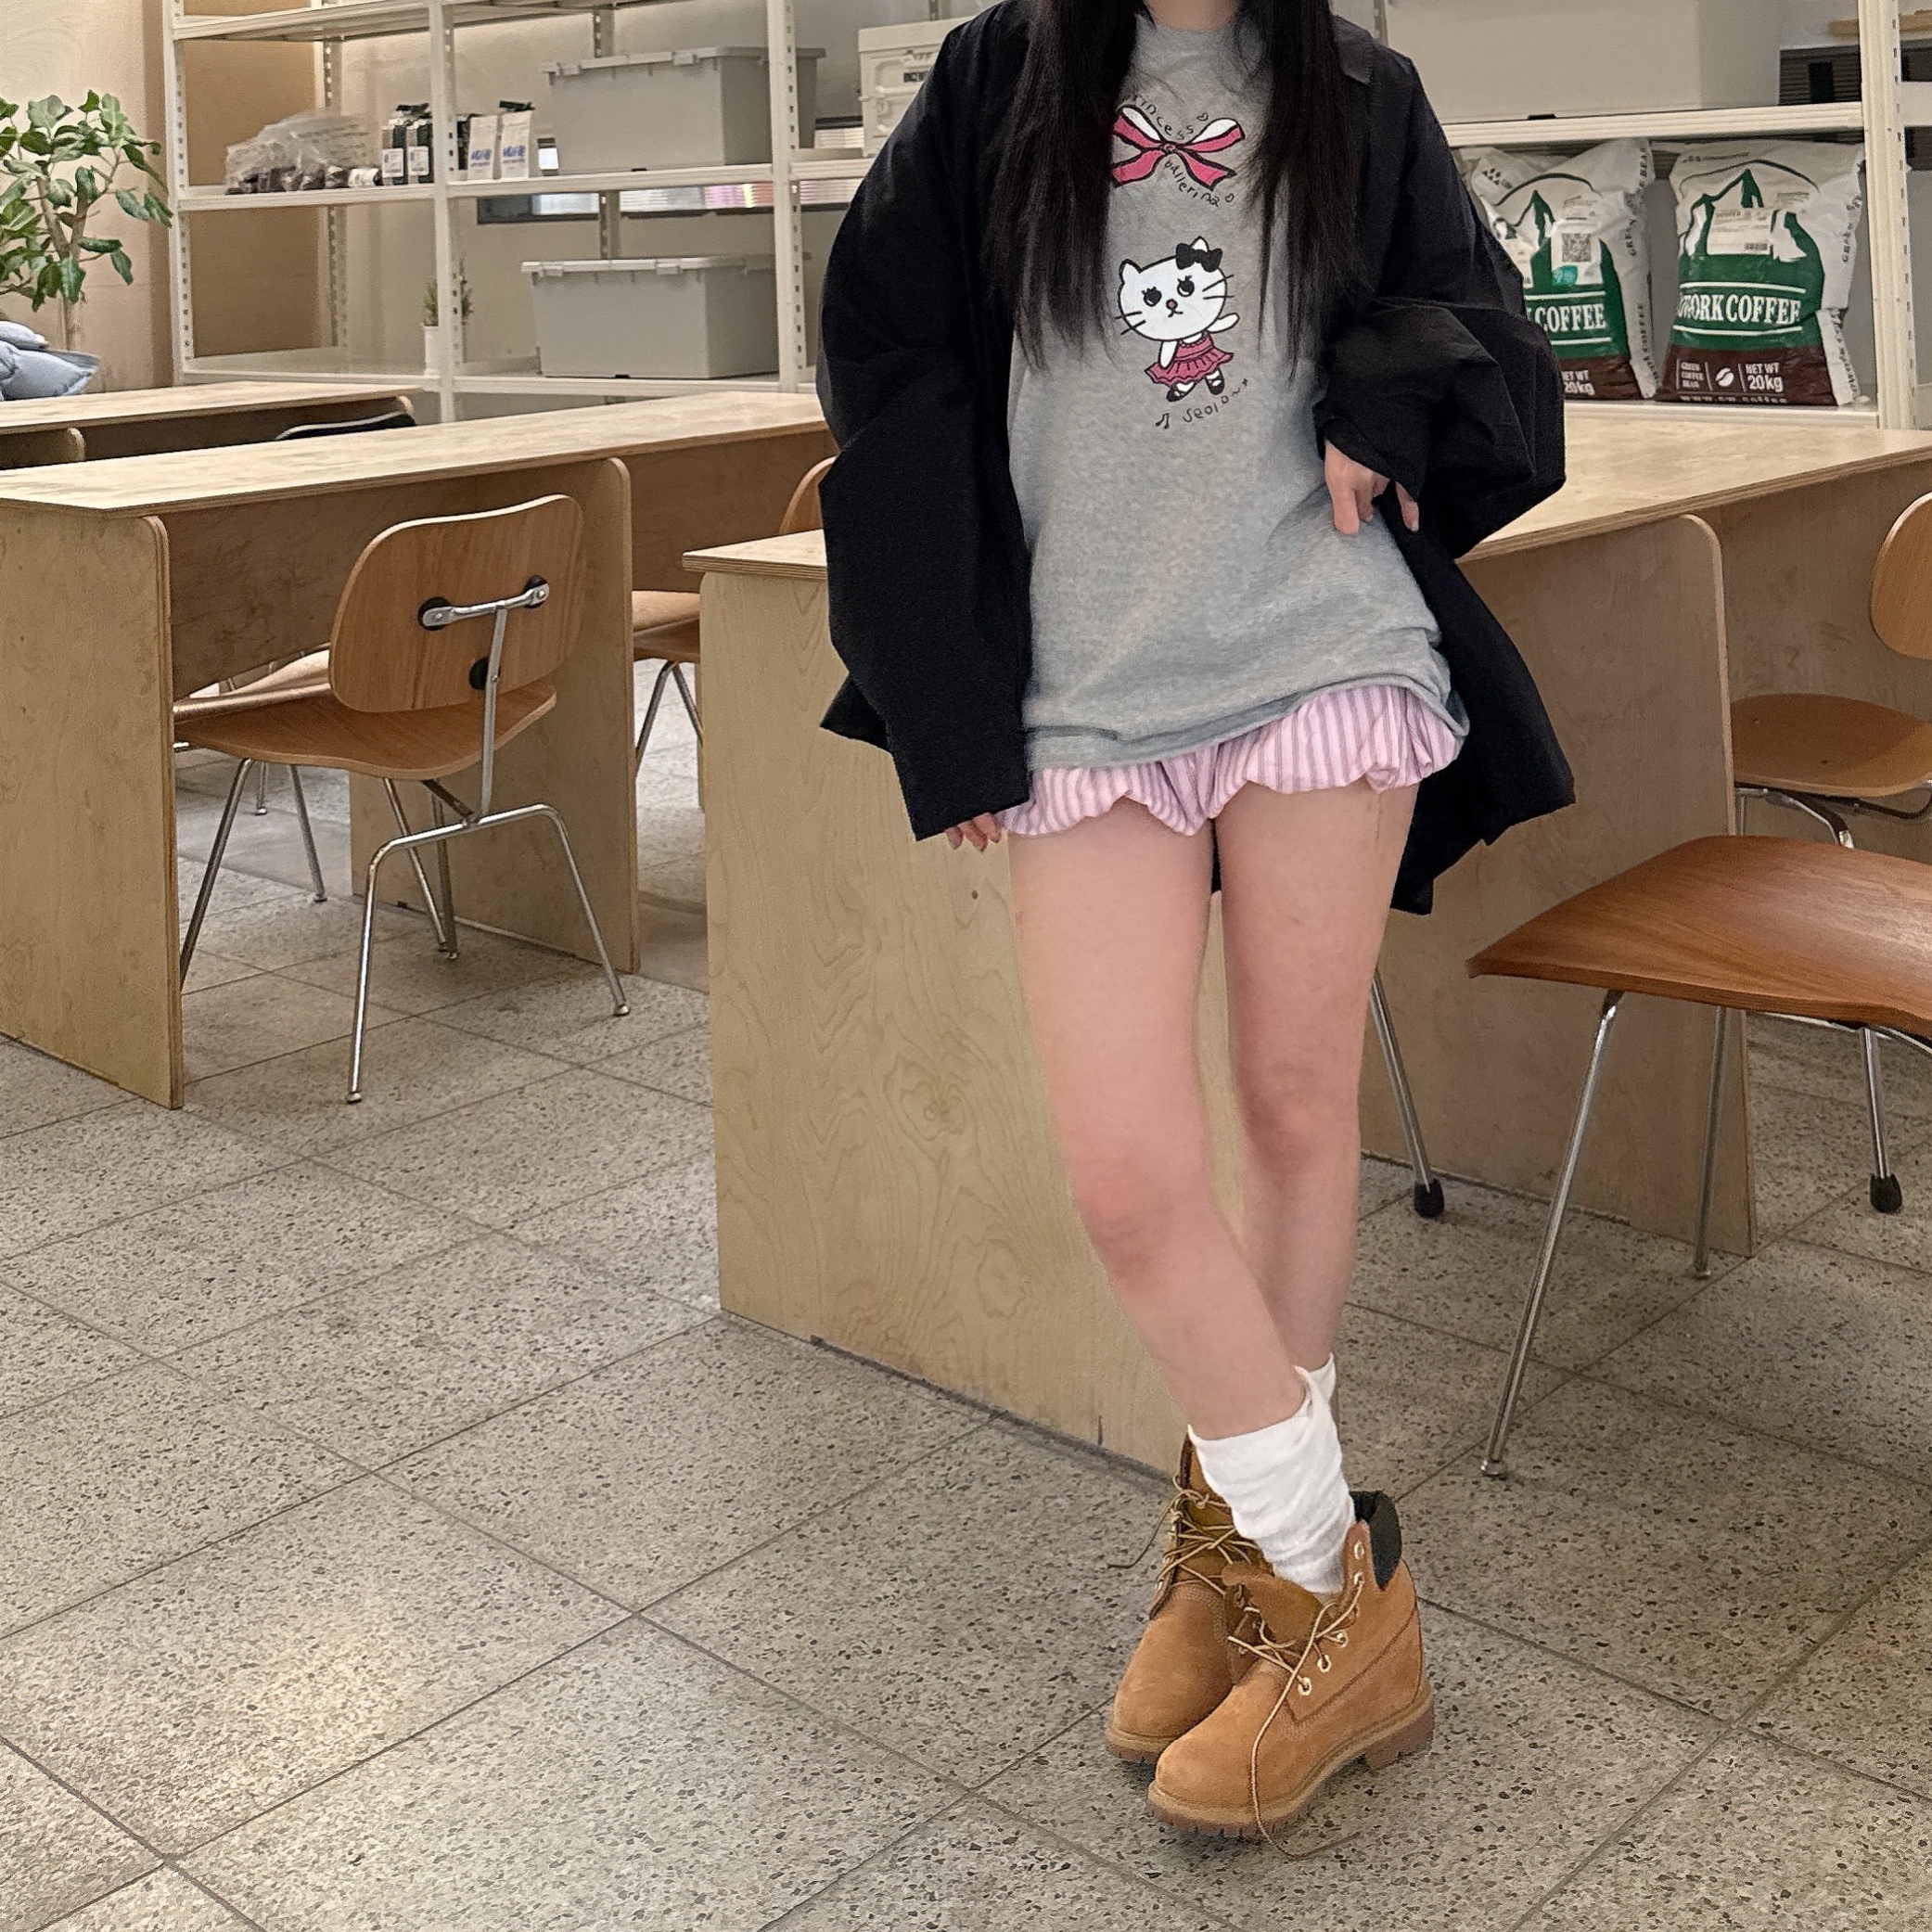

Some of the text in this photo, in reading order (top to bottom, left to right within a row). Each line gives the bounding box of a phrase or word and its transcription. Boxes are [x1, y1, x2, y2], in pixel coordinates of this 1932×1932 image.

[1533, 302, 1608, 333] COFFEE
[1725, 293, 1801, 325] COFFEE
[1563, 380, 1596, 396] 20kg
[1746, 374, 1785, 393] 20kg
